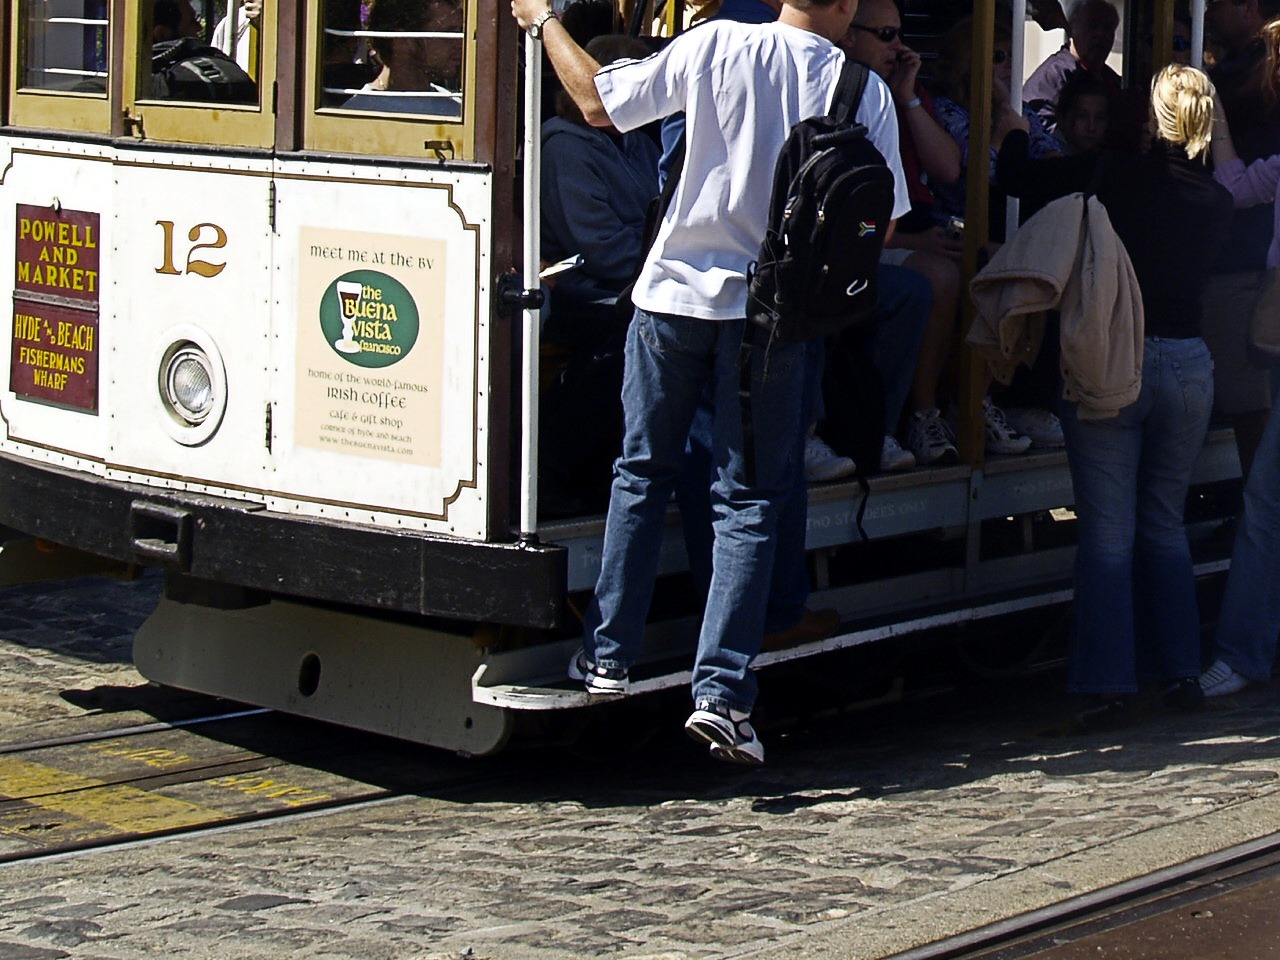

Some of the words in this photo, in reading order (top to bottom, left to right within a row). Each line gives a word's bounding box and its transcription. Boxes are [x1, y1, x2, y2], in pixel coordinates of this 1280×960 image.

[20, 218, 97, 248] POWELL
[39, 246, 78, 265] AND
[155, 220, 228, 278] 12
[310, 245, 343, 260] meet
[348, 249, 368, 262] me
[390, 252, 414, 268] the
[418, 257, 434, 269] BV
[18, 261, 97, 292] MARKET
[362, 285, 382, 300] the
[14, 314, 42, 342] HYDE
[42, 319, 57, 345] AND
[57, 321, 94, 352] BEACH
[20, 346, 86, 374] FISHERMANS
[33, 368, 69, 391] WHARF
[308, 368, 332, 380] home
[334, 372, 344, 382] of
[346, 373, 361, 384] the
